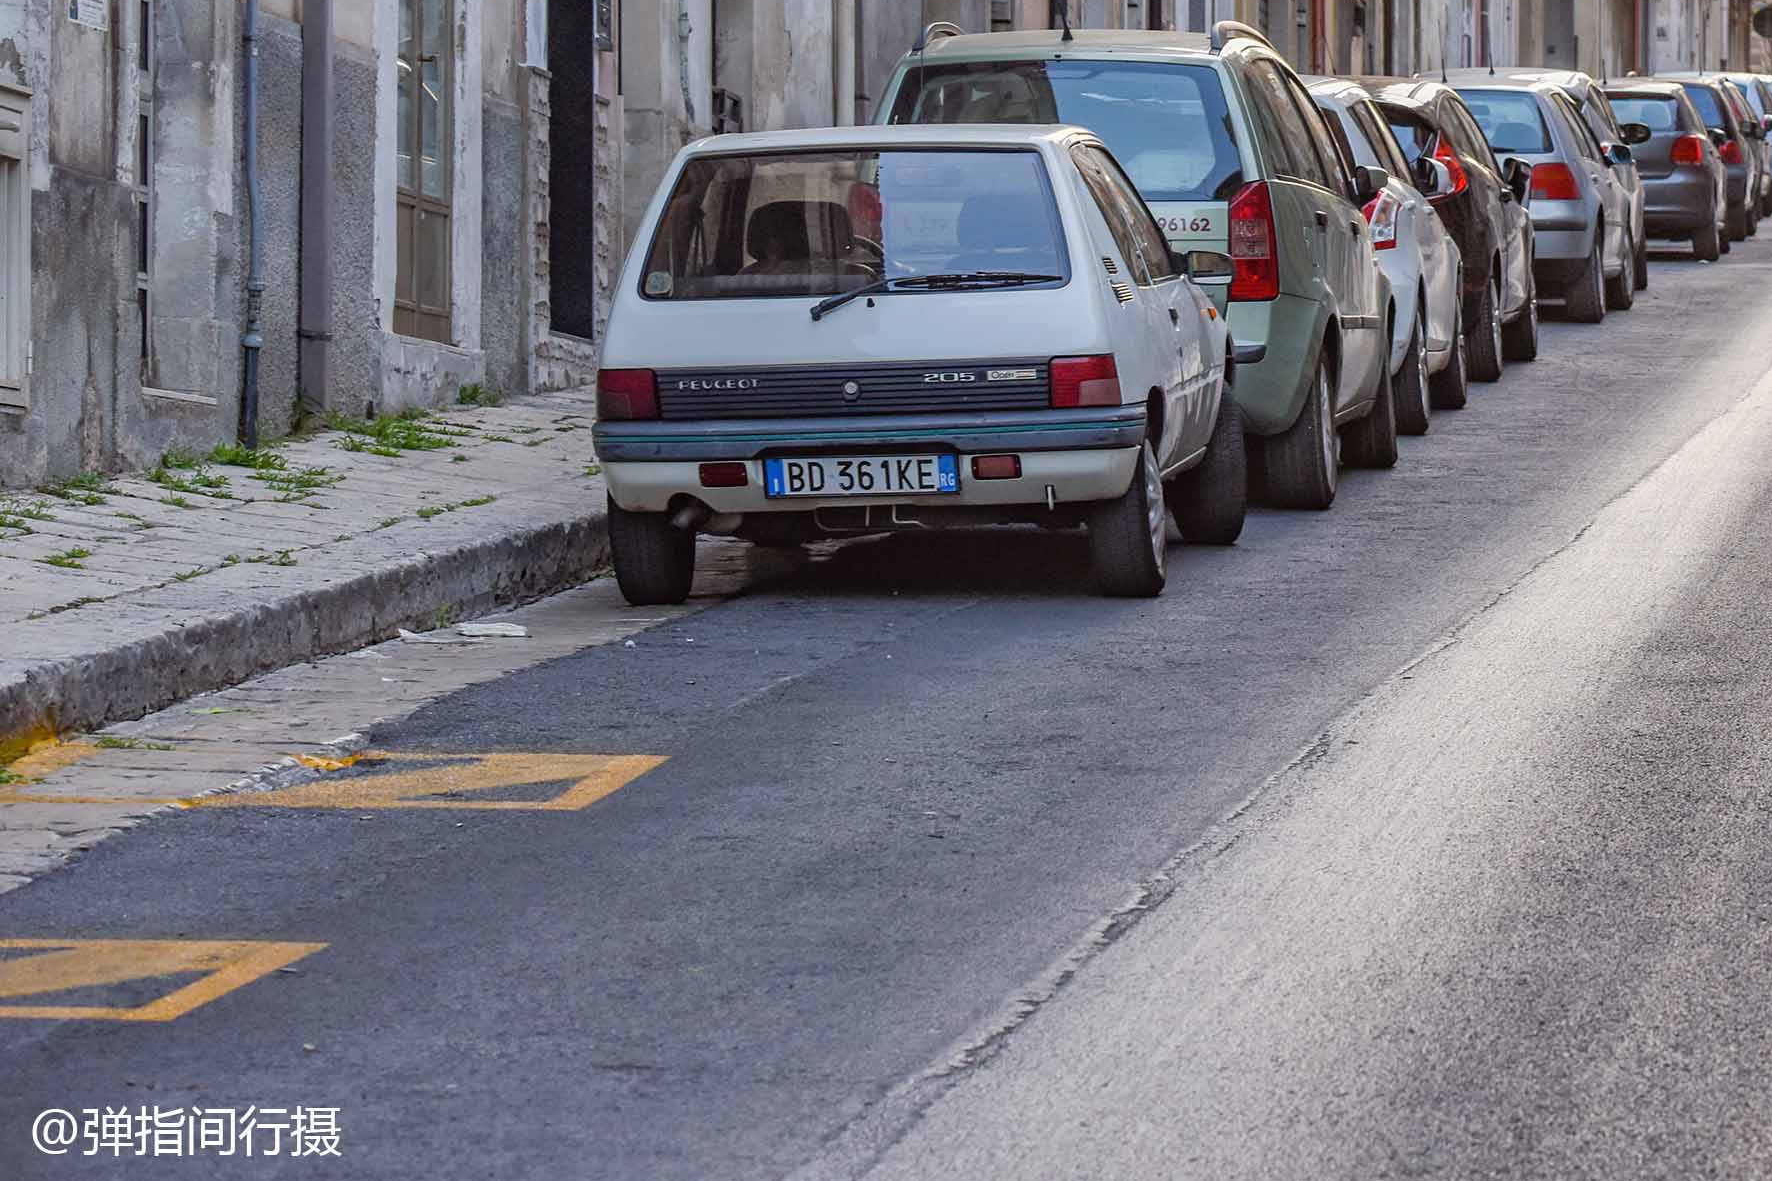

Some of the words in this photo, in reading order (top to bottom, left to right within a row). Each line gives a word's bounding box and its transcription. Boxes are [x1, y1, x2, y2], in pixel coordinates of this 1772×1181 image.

[1157, 217, 1211, 232] 96162
[924, 372, 976, 383] 205
[679, 379, 760, 390] PEUGEOT
[788, 462, 825, 492] BD
[939, 473, 955, 487] RG
